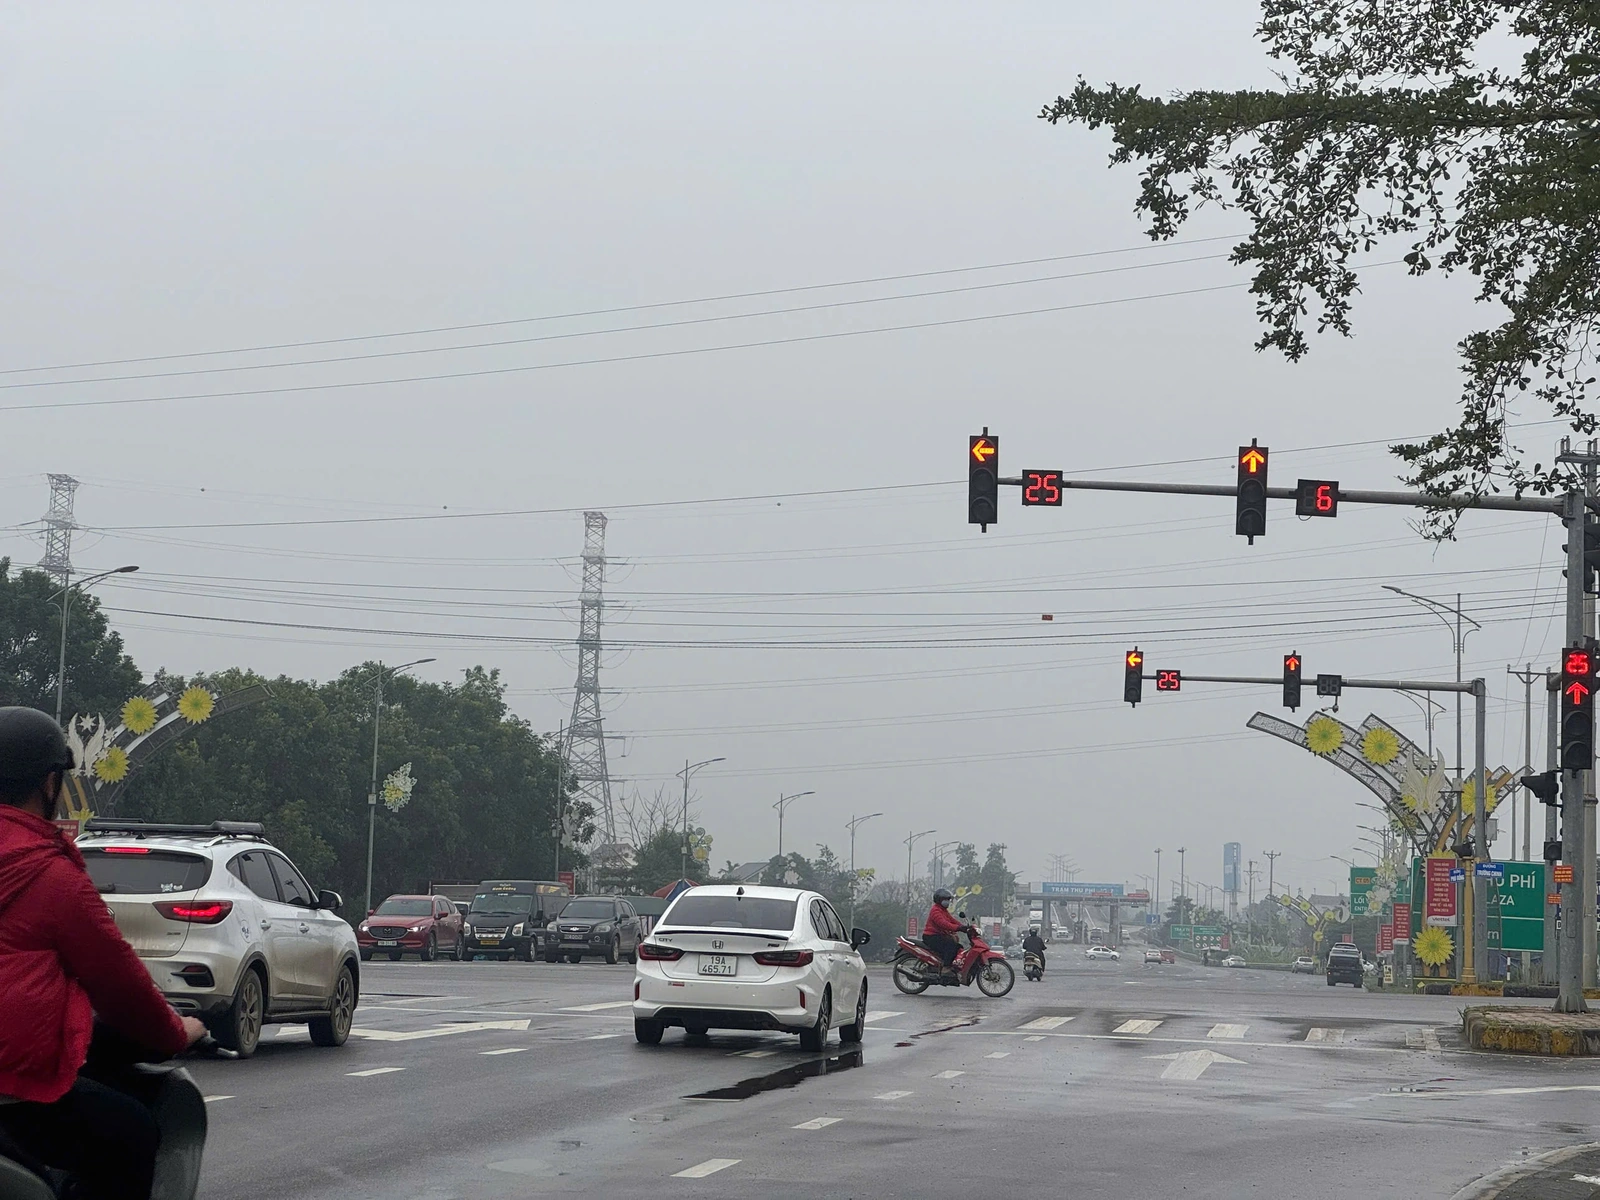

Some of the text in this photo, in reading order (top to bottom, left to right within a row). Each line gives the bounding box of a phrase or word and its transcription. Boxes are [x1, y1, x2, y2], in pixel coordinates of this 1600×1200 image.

[1026, 473, 1059, 502] 25
[1316, 485, 1333, 511] 6
[1158, 671, 1179, 689] 25
[1509, 871, 1536, 889] PHÍ
[702, 965, 732, 974] 465.71
[710, 956, 726, 965] 19A
